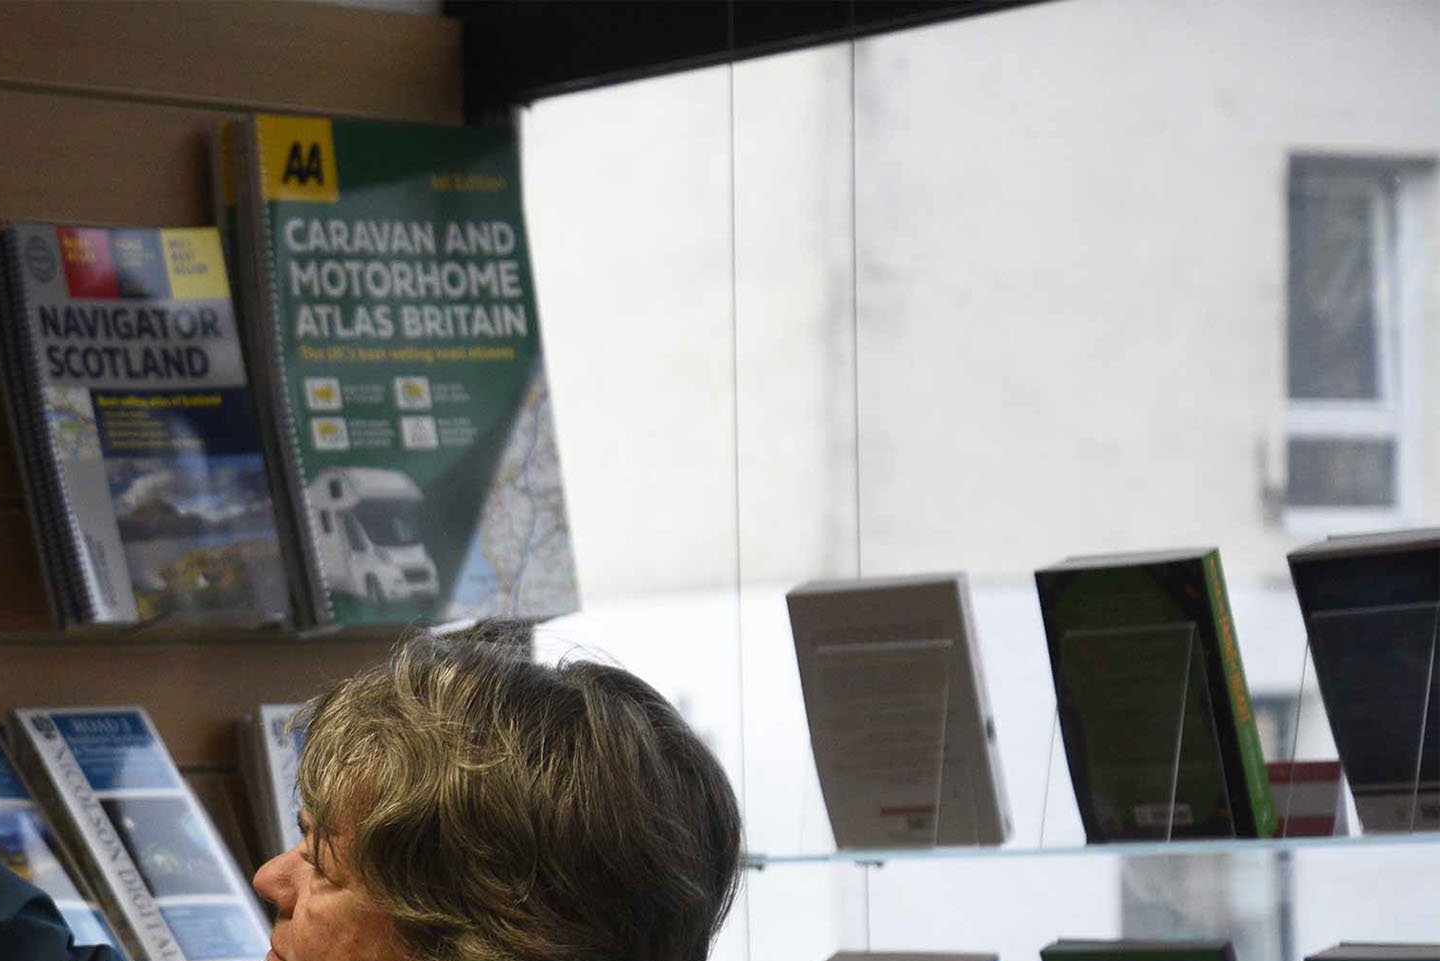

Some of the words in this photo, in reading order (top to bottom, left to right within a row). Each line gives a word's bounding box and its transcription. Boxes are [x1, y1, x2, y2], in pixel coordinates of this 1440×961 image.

[282, 141, 324, 186] AA
[283, 218, 436, 253] CARAVAN
[444, 221, 515, 254] AND
[288, 259, 523, 299] MOTORHOME
[38, 305, 222, 340] NAVIGATOR
[295, 304, 395, 338] ATLAS
[400, 304, 528, 338] BRITAIN
[46, 344, 210, 379] SCOTLAND
